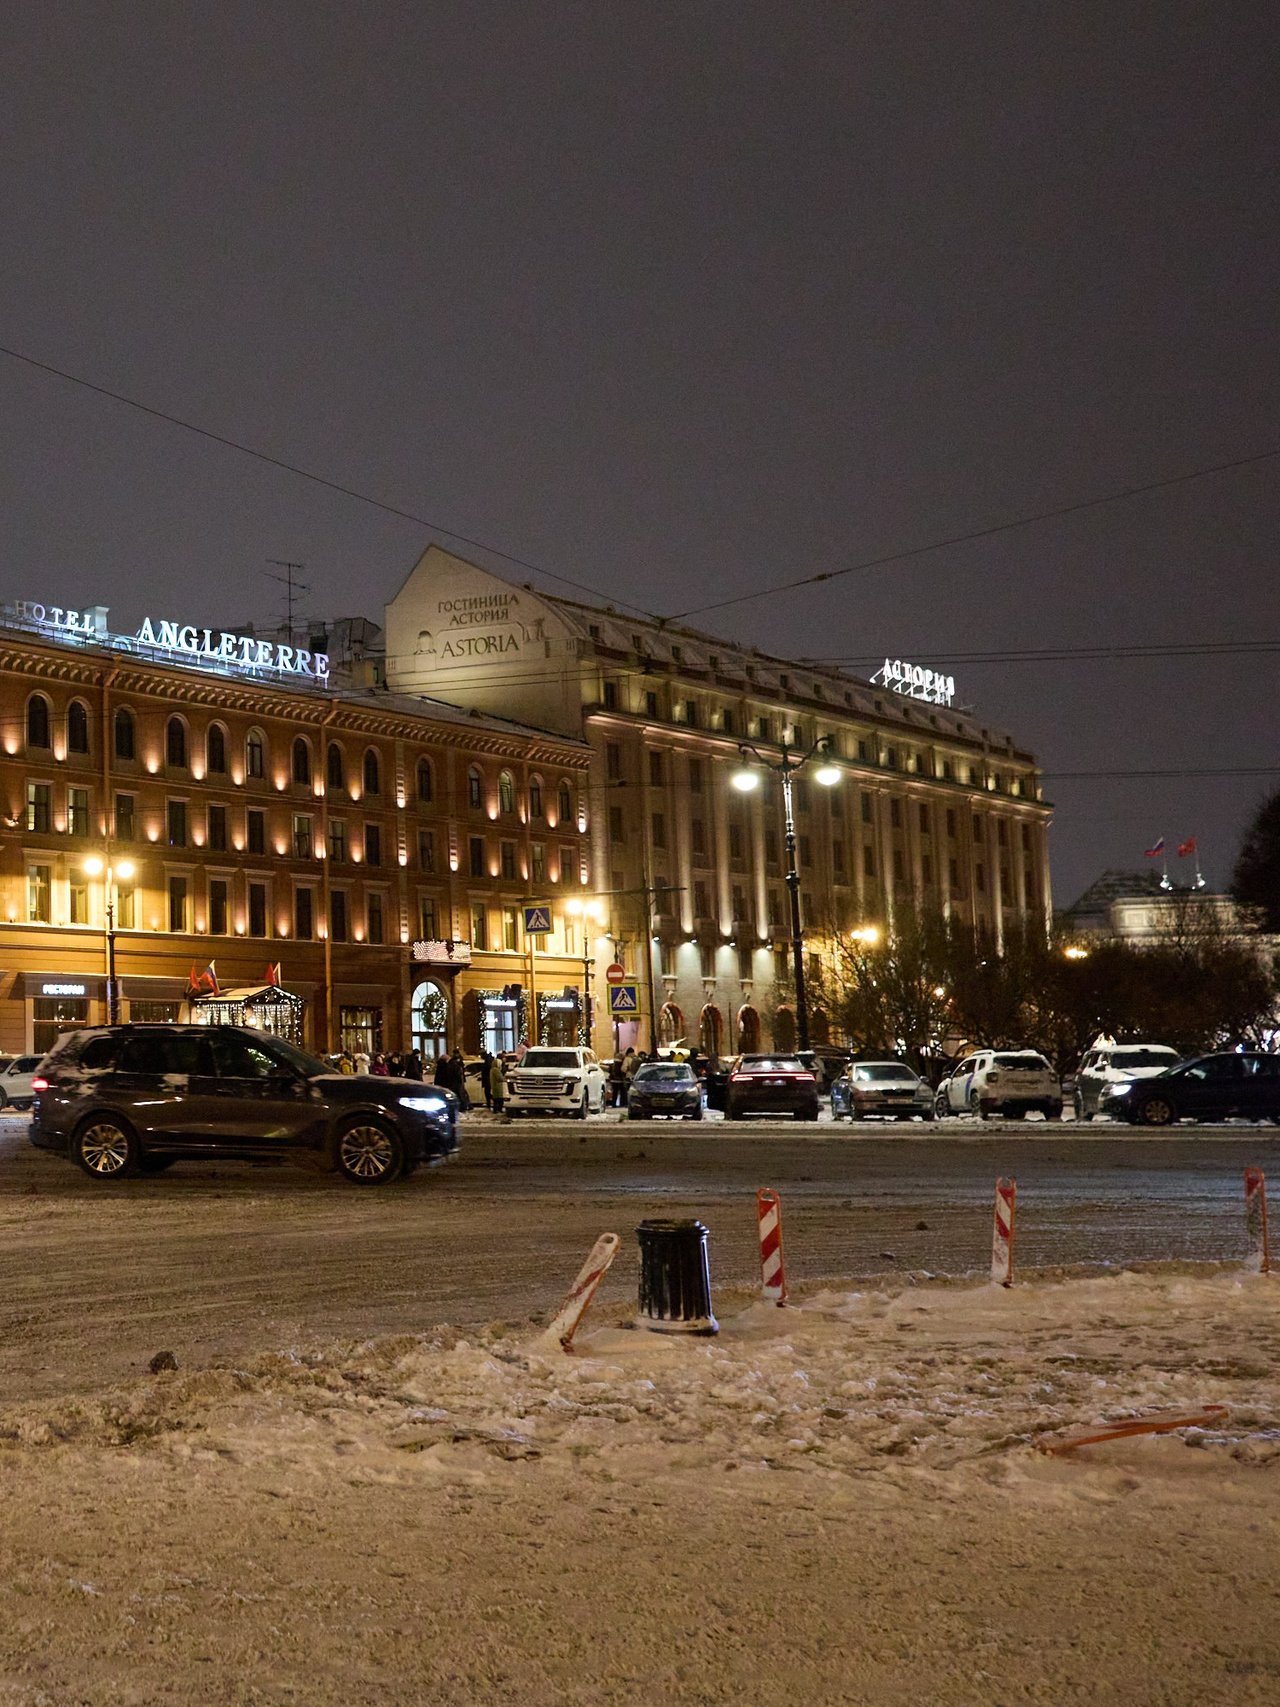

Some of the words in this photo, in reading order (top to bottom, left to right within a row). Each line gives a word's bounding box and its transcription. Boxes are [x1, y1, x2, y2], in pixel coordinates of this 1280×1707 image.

[438, 594, 520, 613] ГОСТИНИЦА
[450, 608, 509, 626] АСТОРИЯ
[15, 600, 95, 633] HOTEL
[138, 617, 332, 678] ANGLETERRE
[441, 633, 520, 659] ASTORIA
[882, 658, 956, 697] АСТОРИЯ
